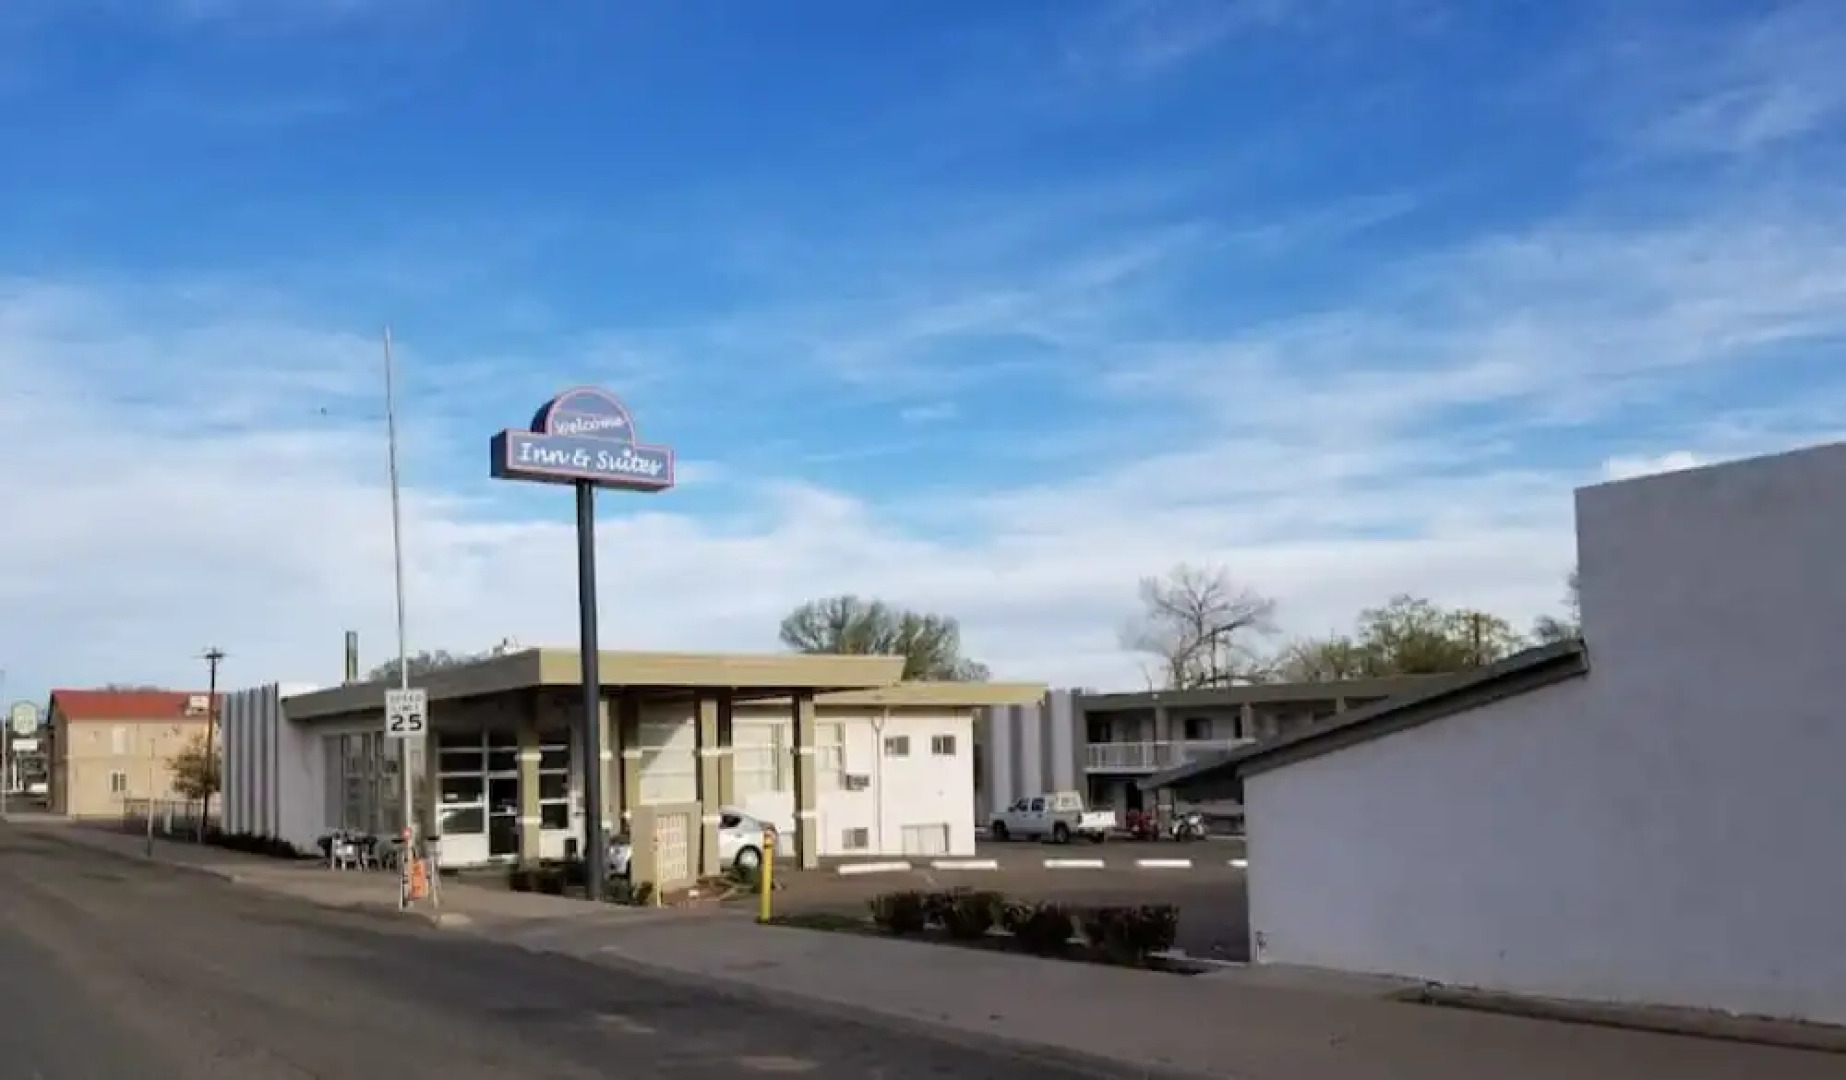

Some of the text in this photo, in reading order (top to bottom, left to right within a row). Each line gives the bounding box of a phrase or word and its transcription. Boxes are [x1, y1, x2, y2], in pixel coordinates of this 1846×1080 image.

[517, 443, 662, 475] Inn & Suites
[391, 714, 422, 732] 25
